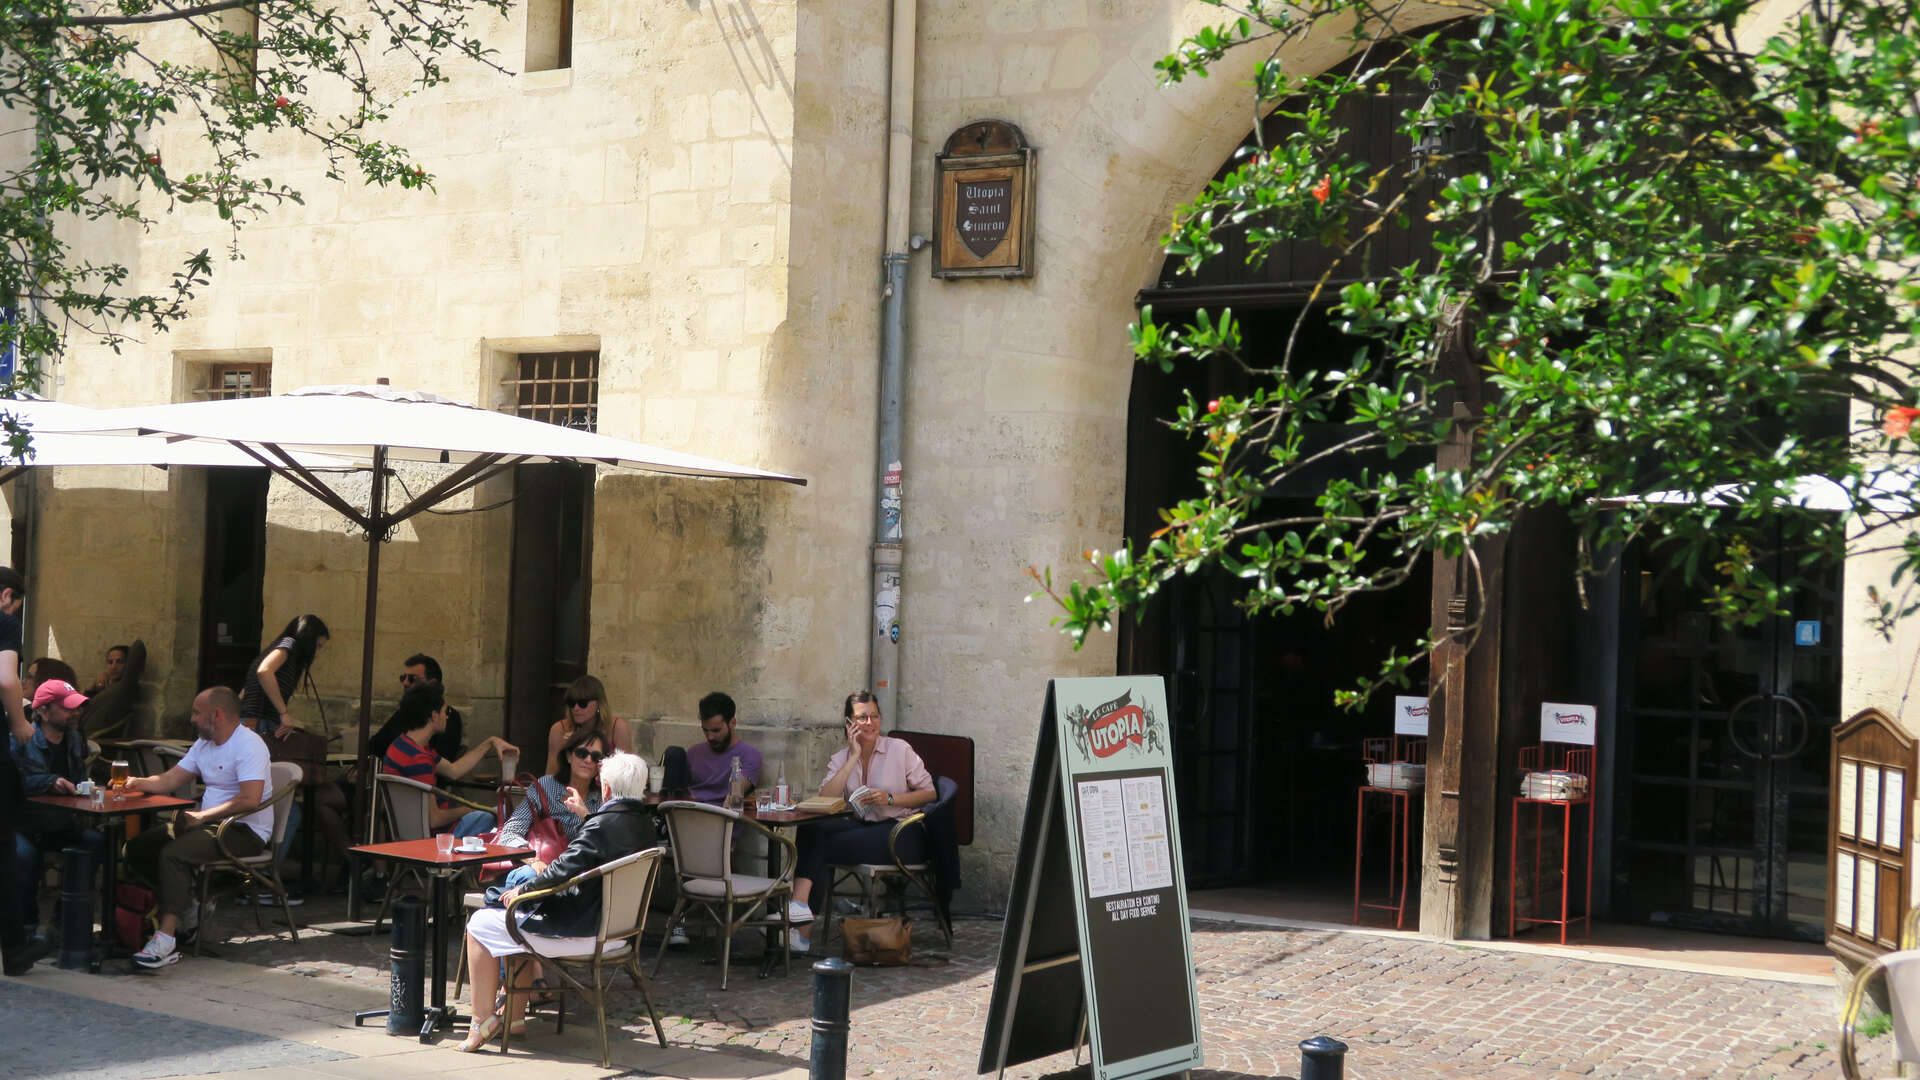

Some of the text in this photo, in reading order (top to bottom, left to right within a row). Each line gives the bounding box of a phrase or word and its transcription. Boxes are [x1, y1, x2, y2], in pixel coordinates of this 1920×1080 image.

[966, 186, 1004, 199] Utopia
[968, 202, 1001, 215] Saint
[1090, 712, 1142, 751] UTOPIA
[1135, 897, 1142, 907] EN
[1111, 904, 1157, 922] ALL DAY FOOD SERVICE
